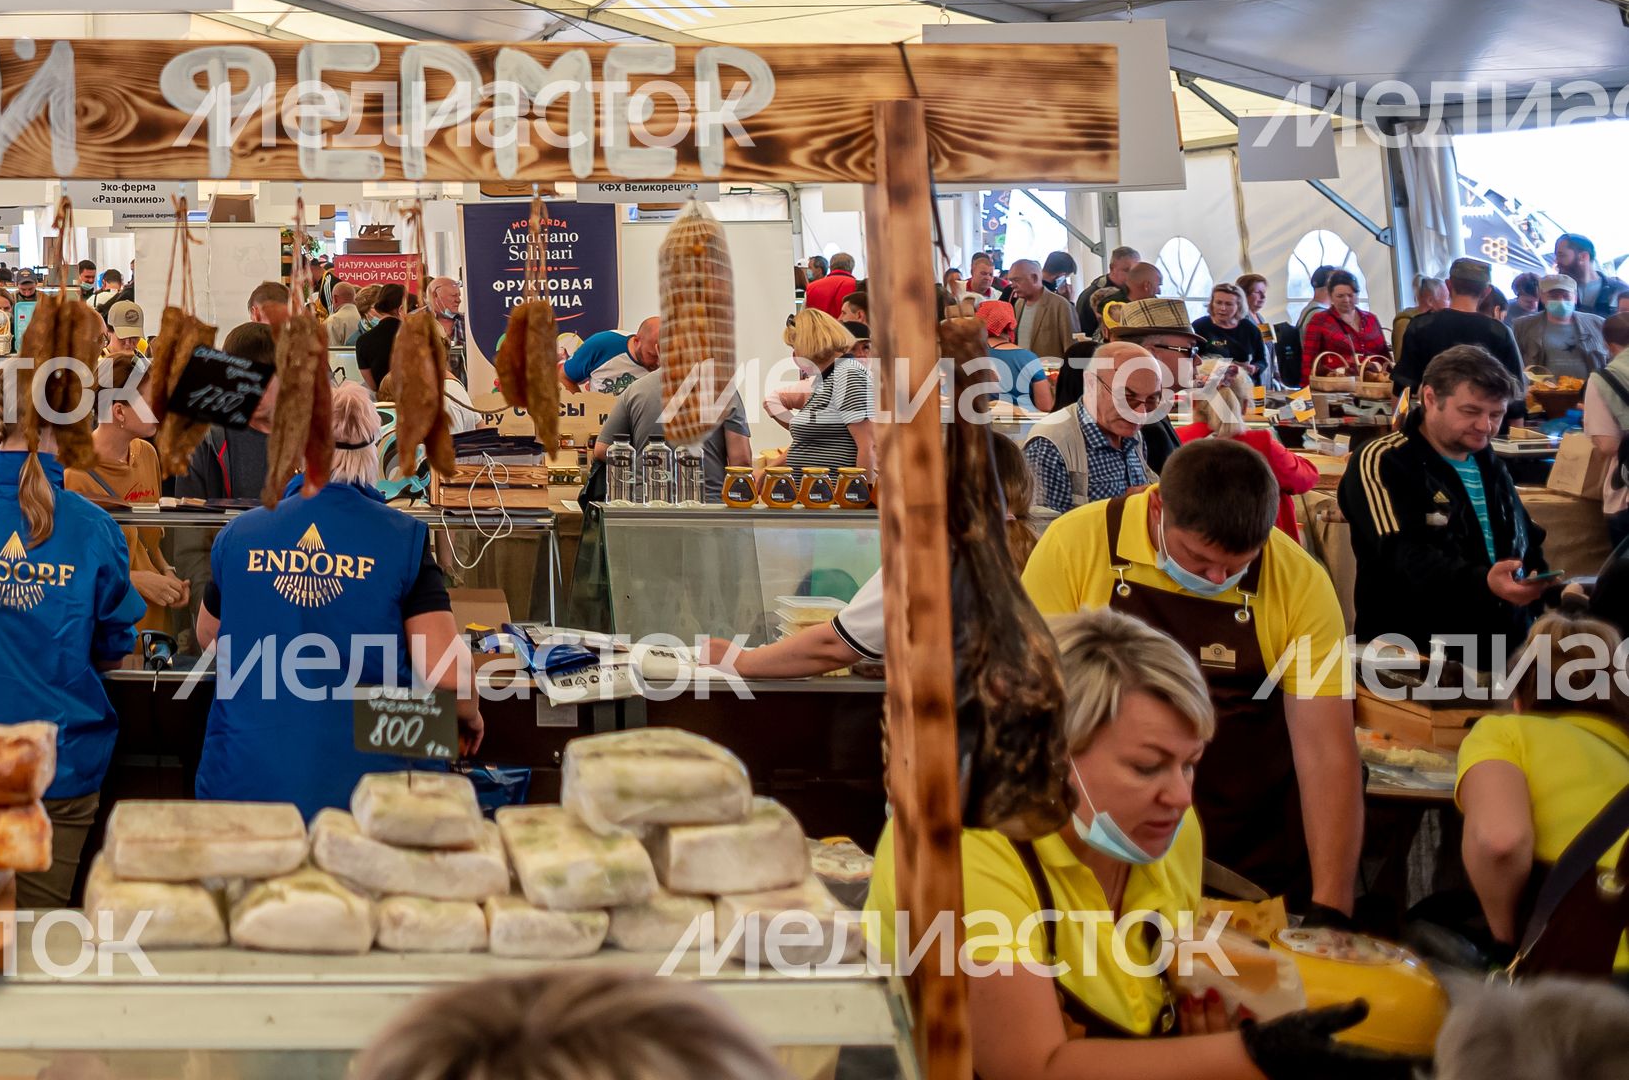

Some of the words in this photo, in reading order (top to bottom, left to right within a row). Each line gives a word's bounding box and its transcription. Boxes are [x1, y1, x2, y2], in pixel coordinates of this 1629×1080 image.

[159, 43, 775, 180] ФЕРМЕР
[101, 183, 156, 193] Эко-ферма
[599, 183, 621, 191] КФХ
[92, 195, 165, 204] «Развилкино»
[512, 218, 567, 229] MOARDA
[502, 228, 579, 244] Andriano
[338, 260, 395, 270] НАТУРАЛЬНЫЙ
[338, 270, 379, 281] РУЧНОЙ
[492, 278, 593, 293] ФРУКТОВАЯ
[247, 549, 375, 579] ENDORF
[369, 713, 424, 747] 800
